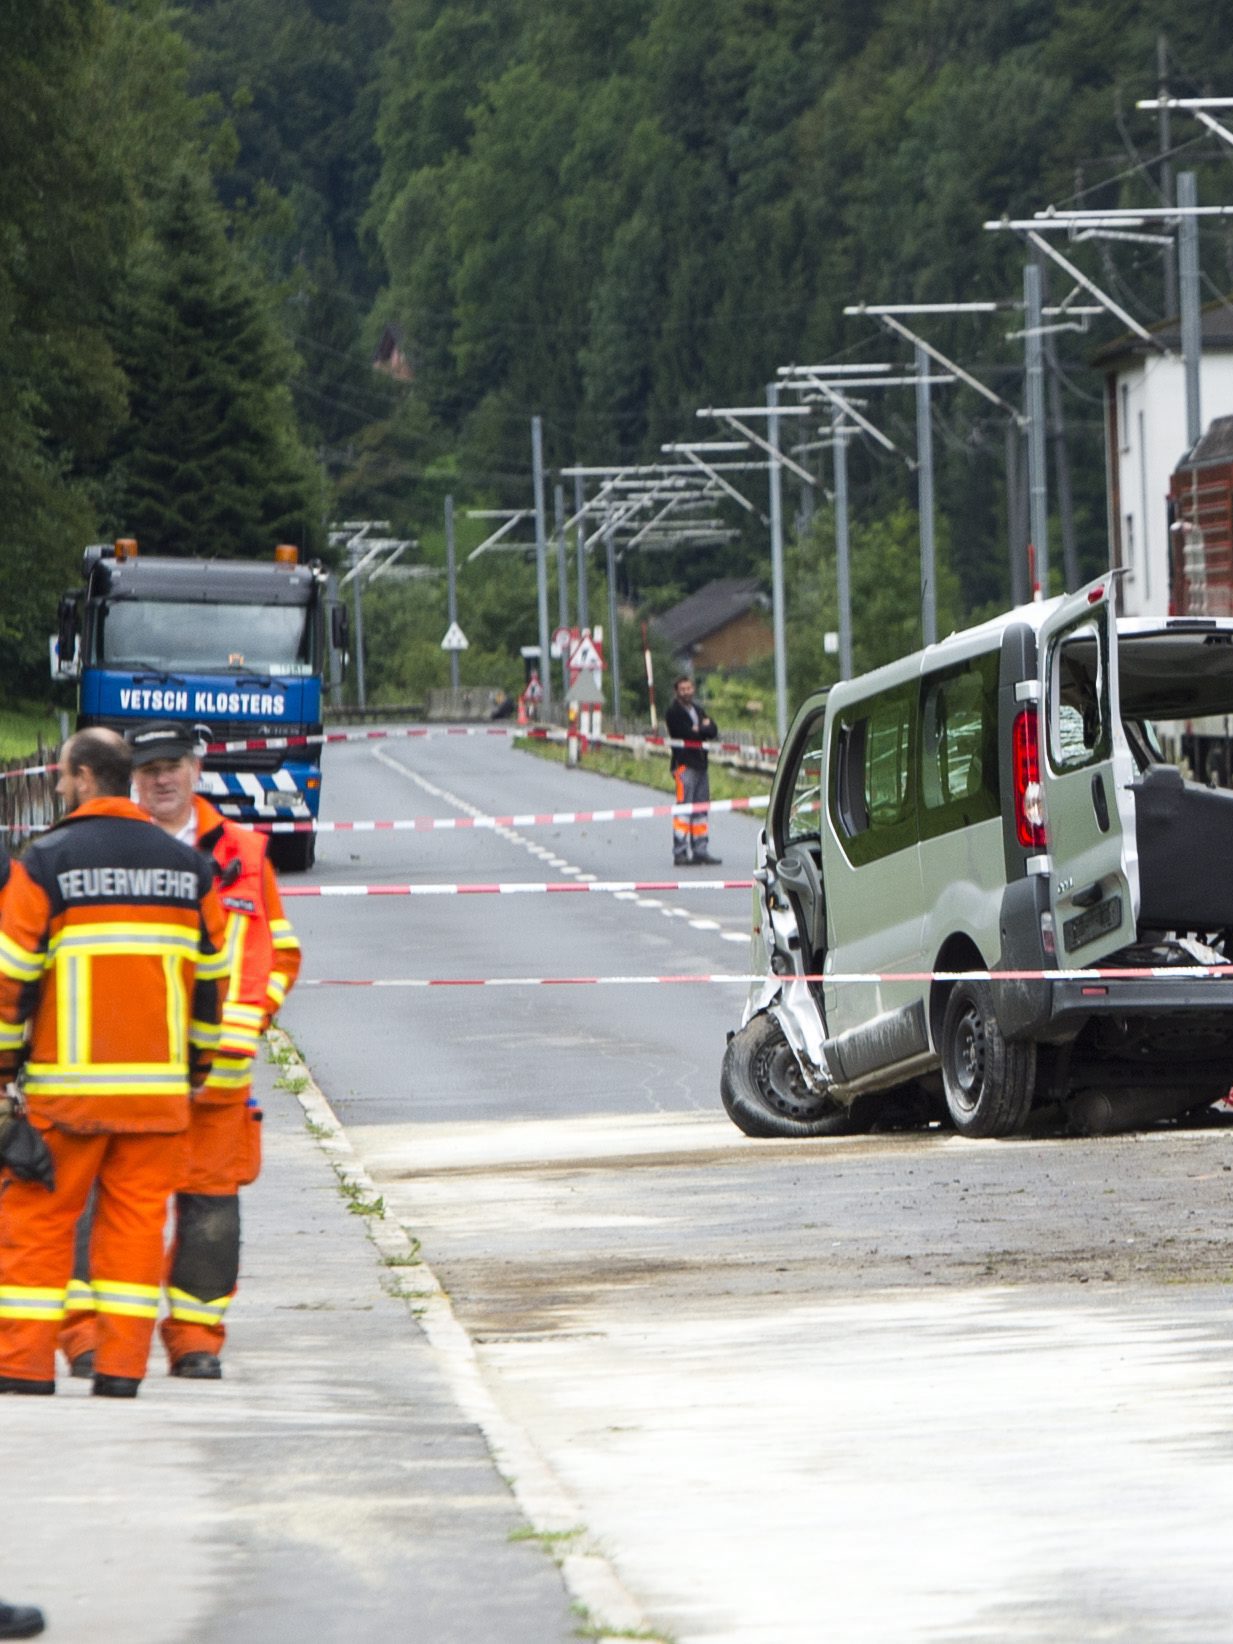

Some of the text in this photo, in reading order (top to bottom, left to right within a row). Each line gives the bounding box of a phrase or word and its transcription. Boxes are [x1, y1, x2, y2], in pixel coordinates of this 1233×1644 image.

[120, 688, 285, 716] VETSCH KLOSTERS
[57, 868, 198, 900] FEUERWEHR
